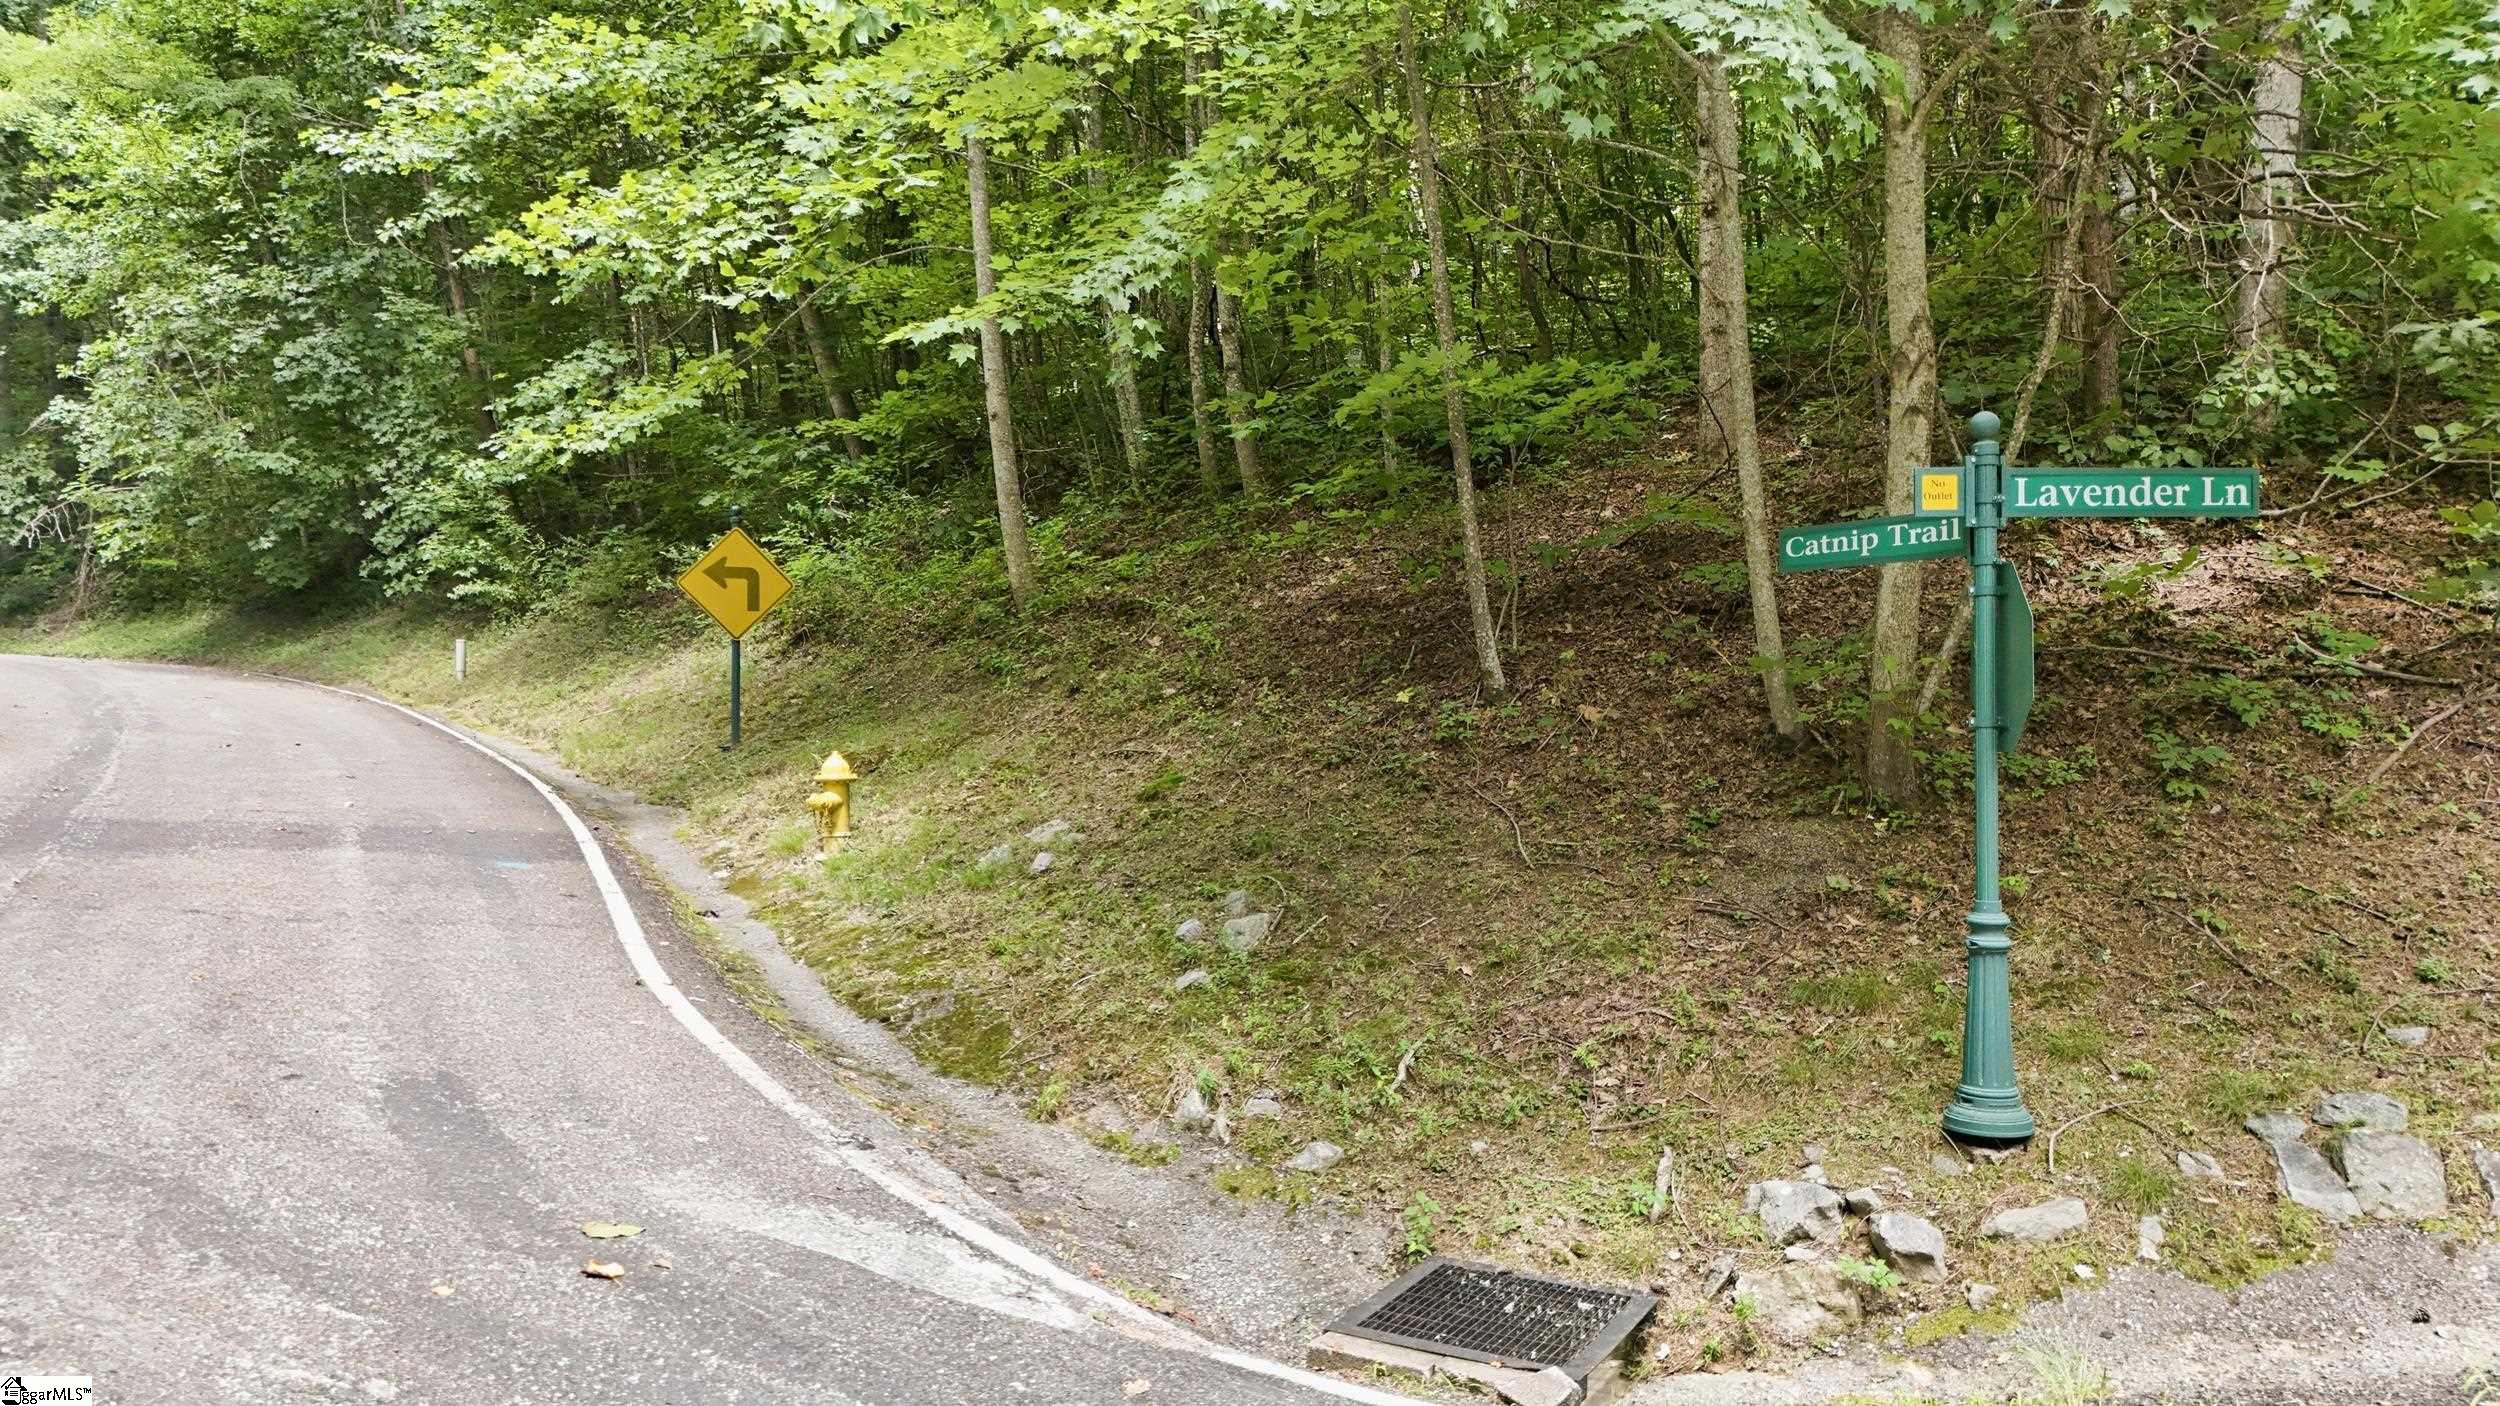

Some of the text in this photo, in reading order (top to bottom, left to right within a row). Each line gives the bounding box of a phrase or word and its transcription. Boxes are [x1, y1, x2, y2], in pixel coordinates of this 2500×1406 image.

[1931, 479, 1946, 487] No
[2014, 476, 2250, 507] Lavender Ln
[1923, 491, 1953, 501] Outlet
[1785, 518, 1961, 558] Catnip Trail
